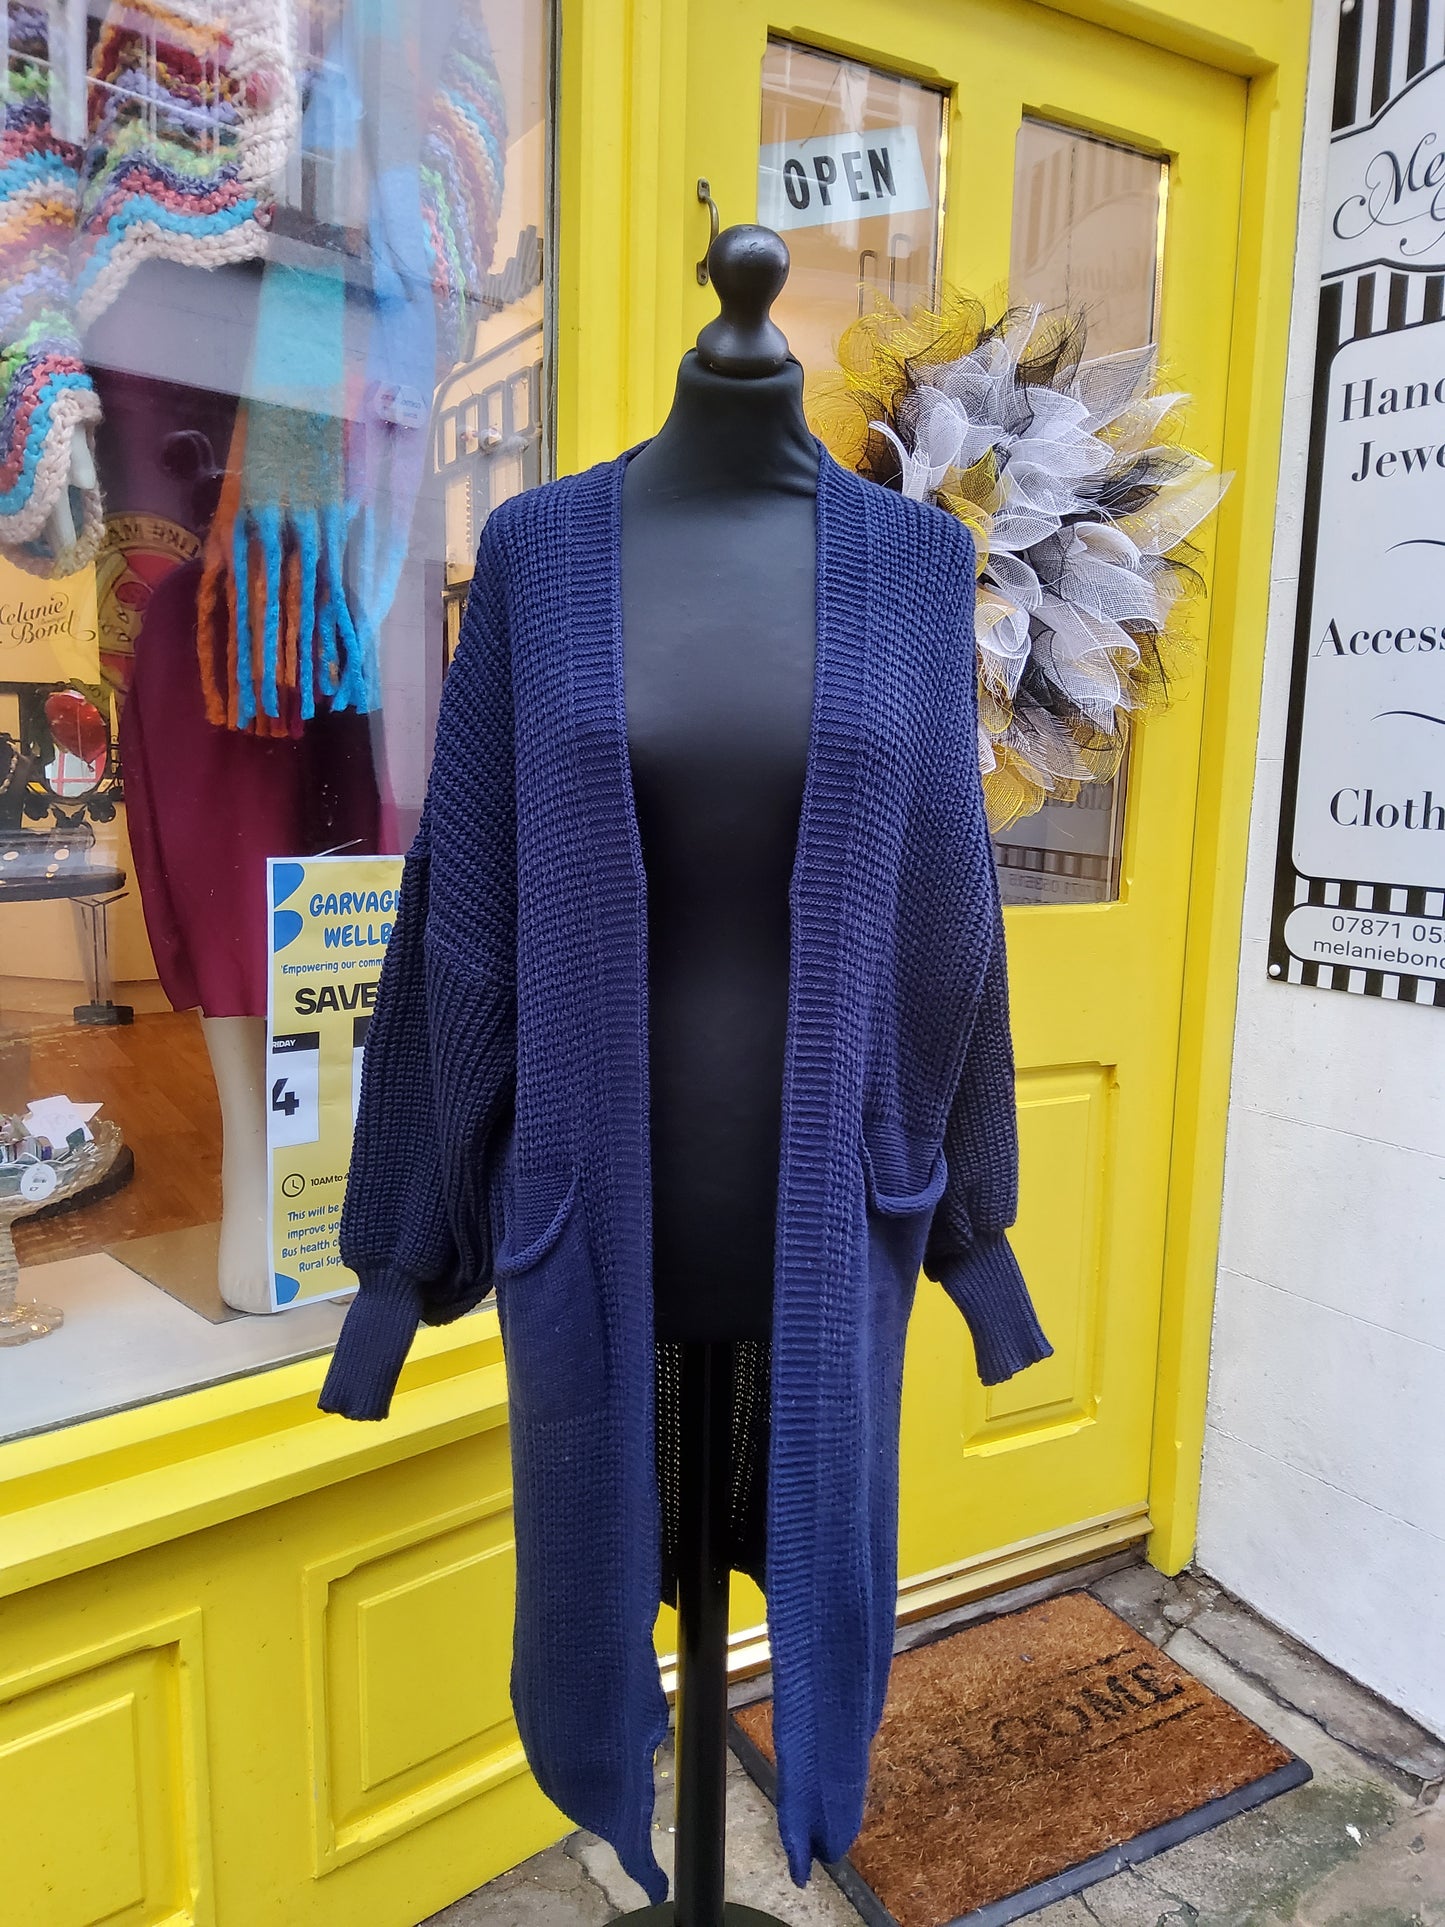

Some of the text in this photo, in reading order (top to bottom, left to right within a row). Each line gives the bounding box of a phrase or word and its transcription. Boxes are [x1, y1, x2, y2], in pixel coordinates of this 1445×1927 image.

[783, 147, 897, 210] OPEN
[6, 610, 96, 646] Bond
[1330, 788, 1445, 831] Cloth
[324, 922, 393, 949] WELLB
[1332, 915, 1445, 944] 07871 05
[341, 960, 356, 970] our
[294, 982, 380, 1015] SAVE
[272, 1077, 300, 1116] 4
[310, 1175, 334, 1187] 10AM
[334, 1174, 343, 1182] to
[287, 1204, 339, 1222] This will be
[287, 1221, 341, 1240] improve yo
[281, 1247, 298, 1258] Bus
[300, 1239, 330, 1254] health
[298, 1257, 324, 1273] Rural
